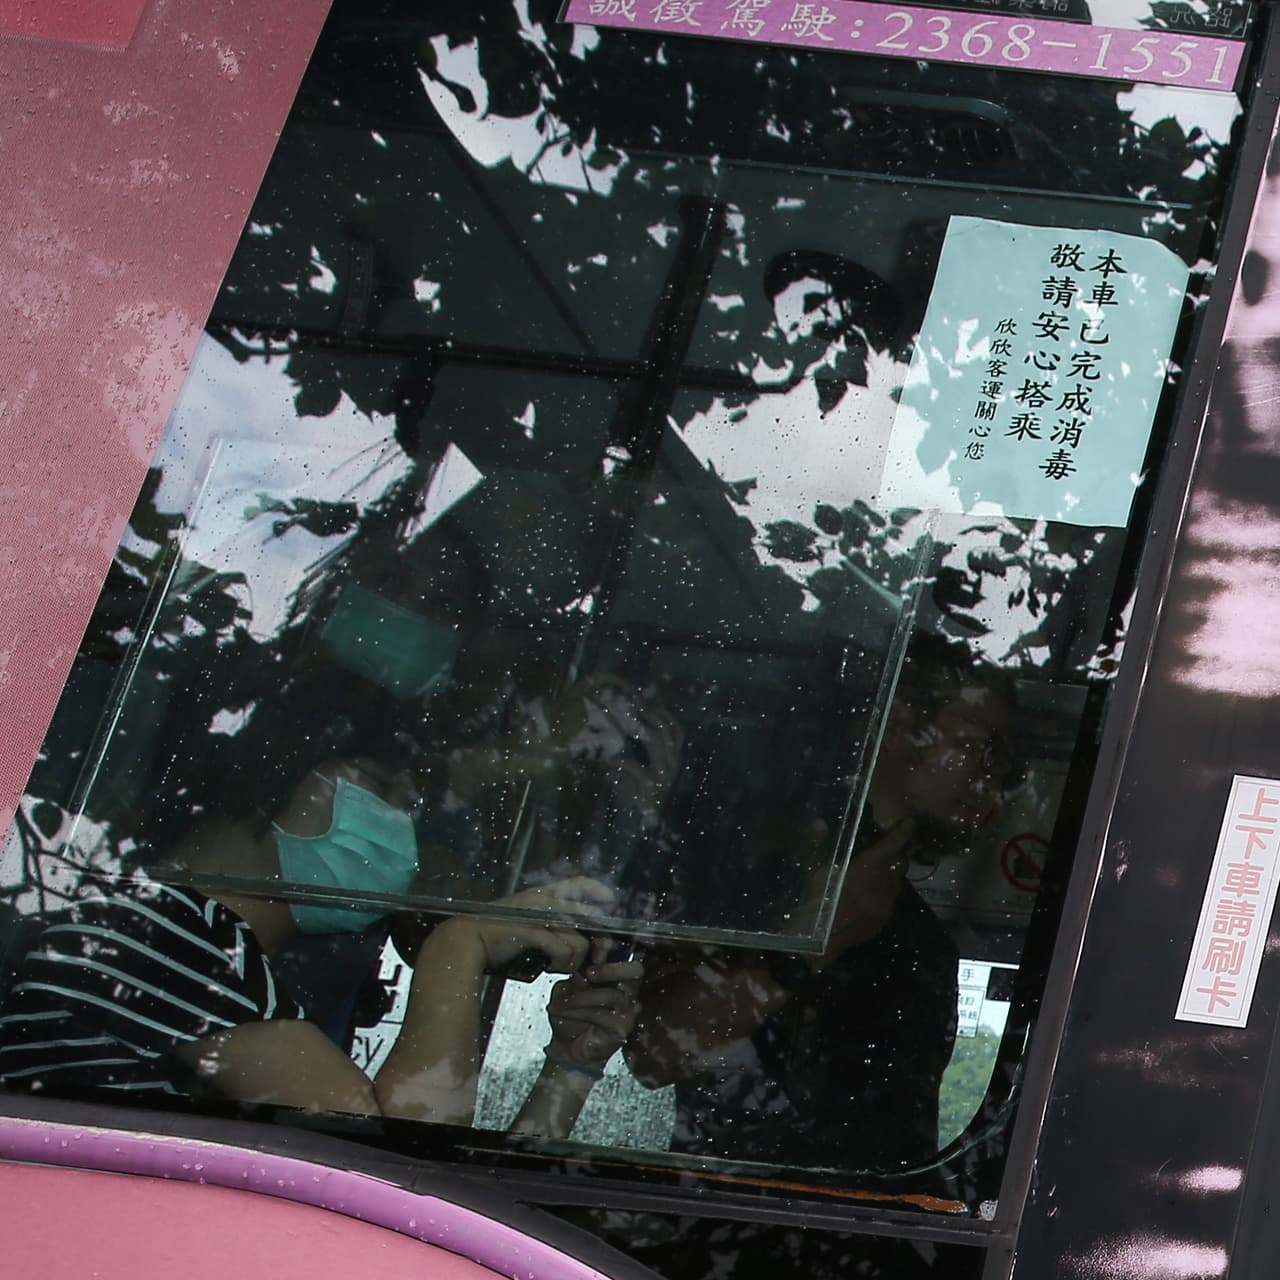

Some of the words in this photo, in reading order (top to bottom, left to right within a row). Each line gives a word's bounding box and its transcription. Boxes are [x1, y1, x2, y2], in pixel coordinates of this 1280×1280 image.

[962, 318, 1017, 461] 欣欣客運關心您
[1004, 243, 1085, 441] 敬請安心搭乘
[1038, 249, 1128, 480] 本車已完成消毒
[1196, 788, 1280, 1013] 上下車請刷卡
